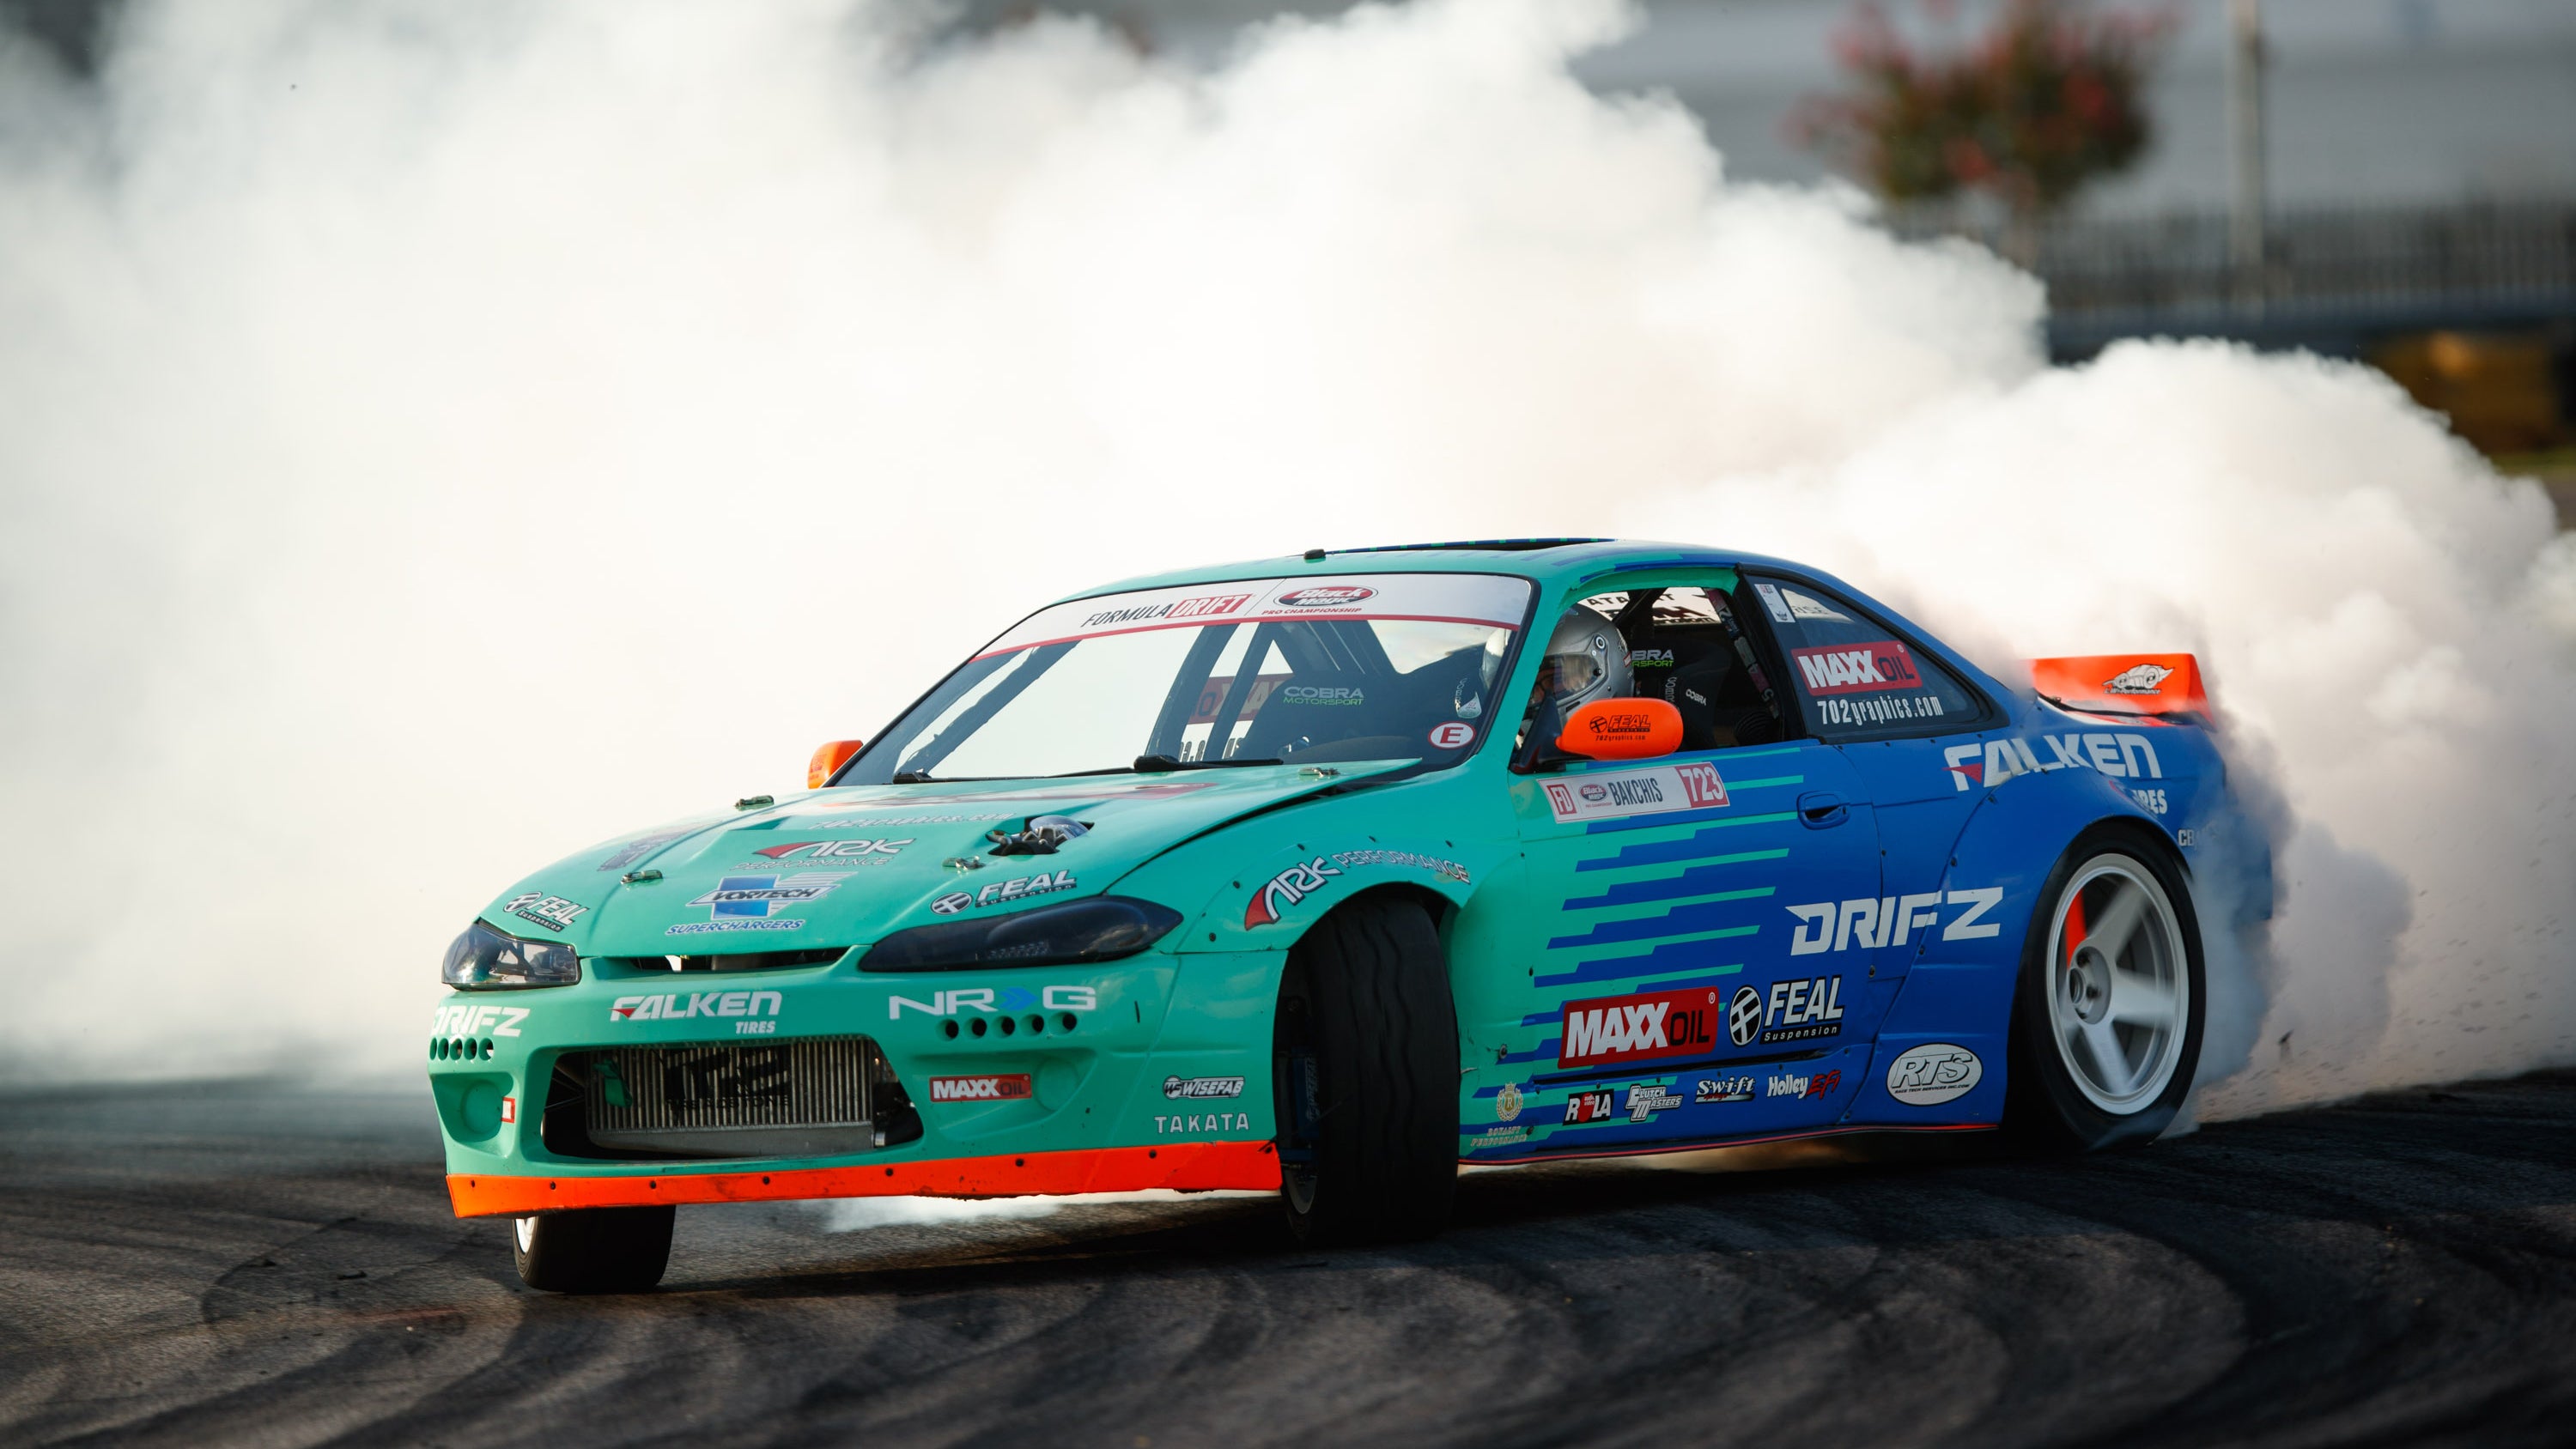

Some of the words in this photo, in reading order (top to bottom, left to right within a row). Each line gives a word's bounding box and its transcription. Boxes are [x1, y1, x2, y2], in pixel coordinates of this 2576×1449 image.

[1080, 603, 1175, 627] FORMULA
[1169, 594, 1245, 618] DRIFT
[1631, 649, 1674, 660] BRA
[1797, 650, 1886, 688] MAXX
[1878, 656, 1915, 682] OIL
[1283, 696, 1365, 706] MOTORSPORT
[1284, 686, 1365, 699] COBRA
[1607, 714, 1651, 729] FEAL
[1817, 695, 1944, 726] 702graphics.com
[1439, 726, 1464, 743] E
[1942, 733, 2162, 791] FALKEN
[1607, 777, 1663, 806] BAKCHIS
[1681, 766, 1724, 803] 723
[1549, 786, 1574, 813] FD
[730, 856, 895, 870] PERFORMANCE
[1331, 849, 1472, 885] PERFORMANCE
[712, 888, 821, 900] VORTECH
[975, 869, 1077, 902] FEAL
[979, 884, 1074, 907] Suspension
[518, 909, 563, 932] Suspension
[524, 894, 590, 926] FEAL
[1785, 887, 2003, 956] DRIFZ
[665, 919, 805, 936] SUPERCHARGERS
[608, 991, 782, 1022] FALKEN
[1764, 977, 1845, 1028] FEAL
[735, 1021, 776, 1035] TIRES
[1565, 1001, 1670, 1058] MAXX
[1668, 1009, 1710, 1047] OIL
[1764, 1025, 1838, 1043] Suspension
[1890, 1052, 1973, 1089] RTS
[933, 1078, 1002, 1100] MAXX
[999, 1081, 1026, 1096] OIL
[1182, 1080, 1244, 1095] WISEFAB
[1627, 1087, 1666, 1106] CLUTCH
[1766, 1074, 1808, 1100] Holley
[1632, 1098, 1681, 1119] MASTERS
[1154, 1113, 1249, 1134] TAKATA
